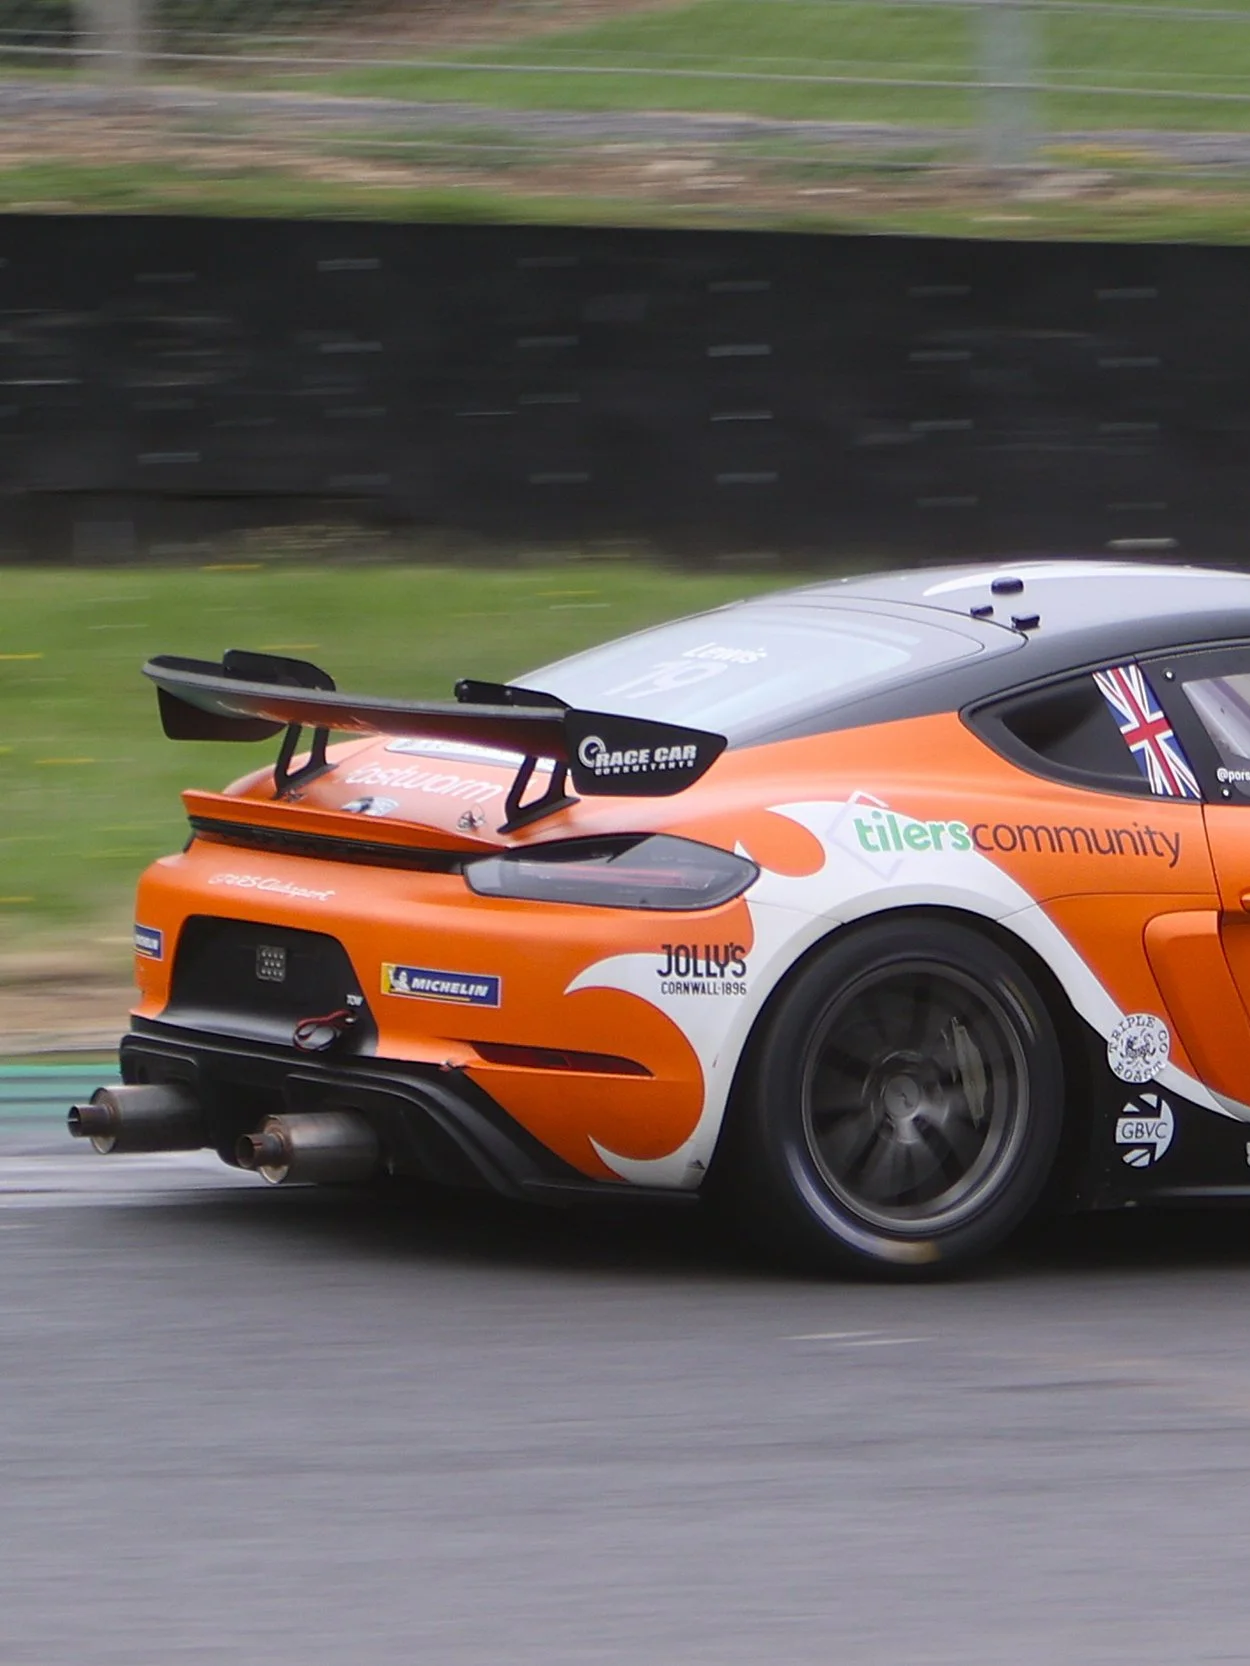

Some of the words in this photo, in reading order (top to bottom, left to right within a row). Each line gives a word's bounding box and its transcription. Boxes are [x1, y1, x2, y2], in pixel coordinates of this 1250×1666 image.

[595, 748, 651, 767] RACE
[654, 745, 697, 762] CAR
[595, 760, 694, 775] CONSULTANTS
[656, 942, 747, 978] JOLLY'S
[411, 977, 489, 997] MICHELIN
[1109, 1015, 1156, 1054] TRIPLE
[1114, 1060, 1163, 1082] ROAST
[1121, 1121, 1168, 1139] GBVC
